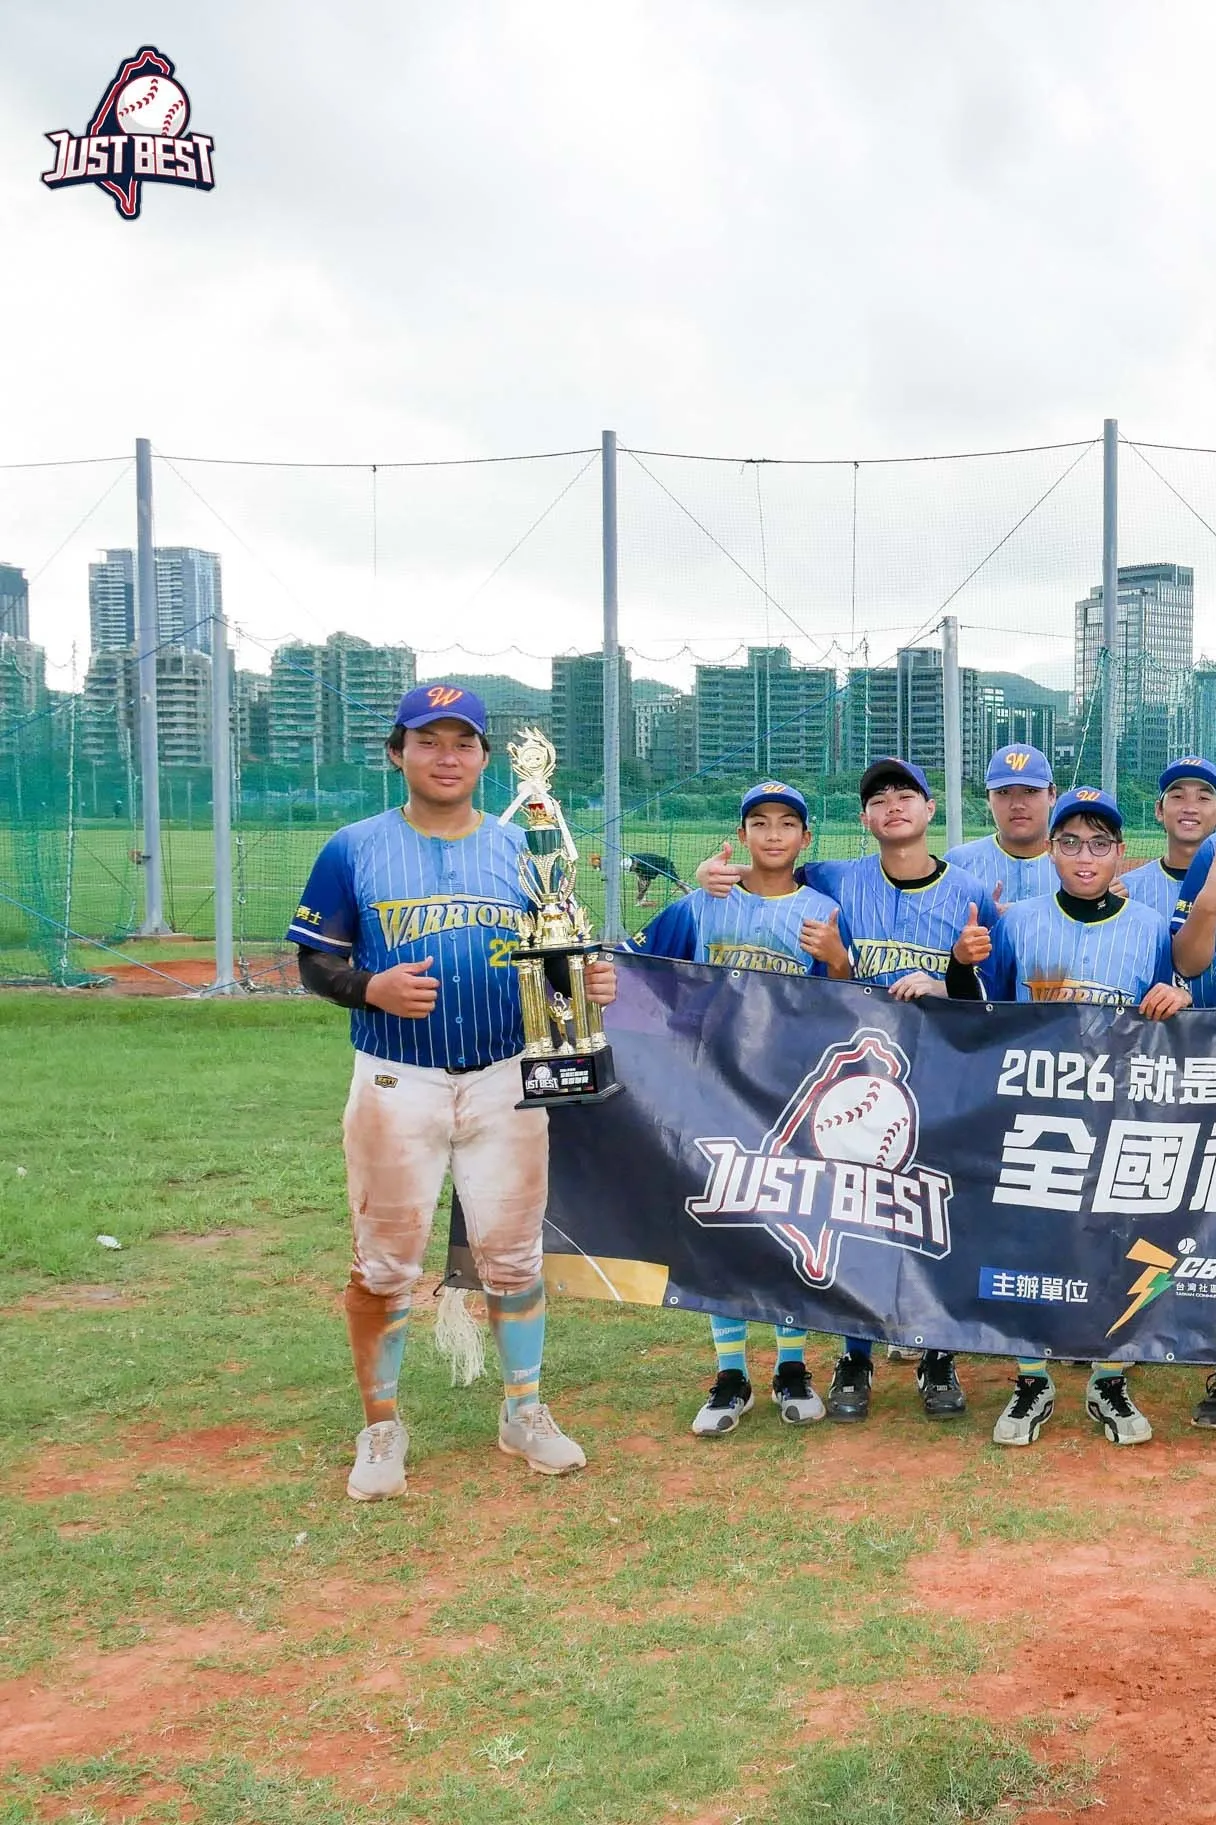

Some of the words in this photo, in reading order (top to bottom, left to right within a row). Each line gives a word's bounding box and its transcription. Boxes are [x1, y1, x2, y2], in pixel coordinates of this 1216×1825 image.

[427, 686, 463, 708] W
[1005, 752, 1029, 771] W
[1076, 790, 1100, 801] W
[996, 1049, 1115, 1102] 2026
[691, 1142, 826, 1216] JUST
[829, 1162, 949, 1247] BEST
[991, 1272, 1089, 1303] 主辦單位
